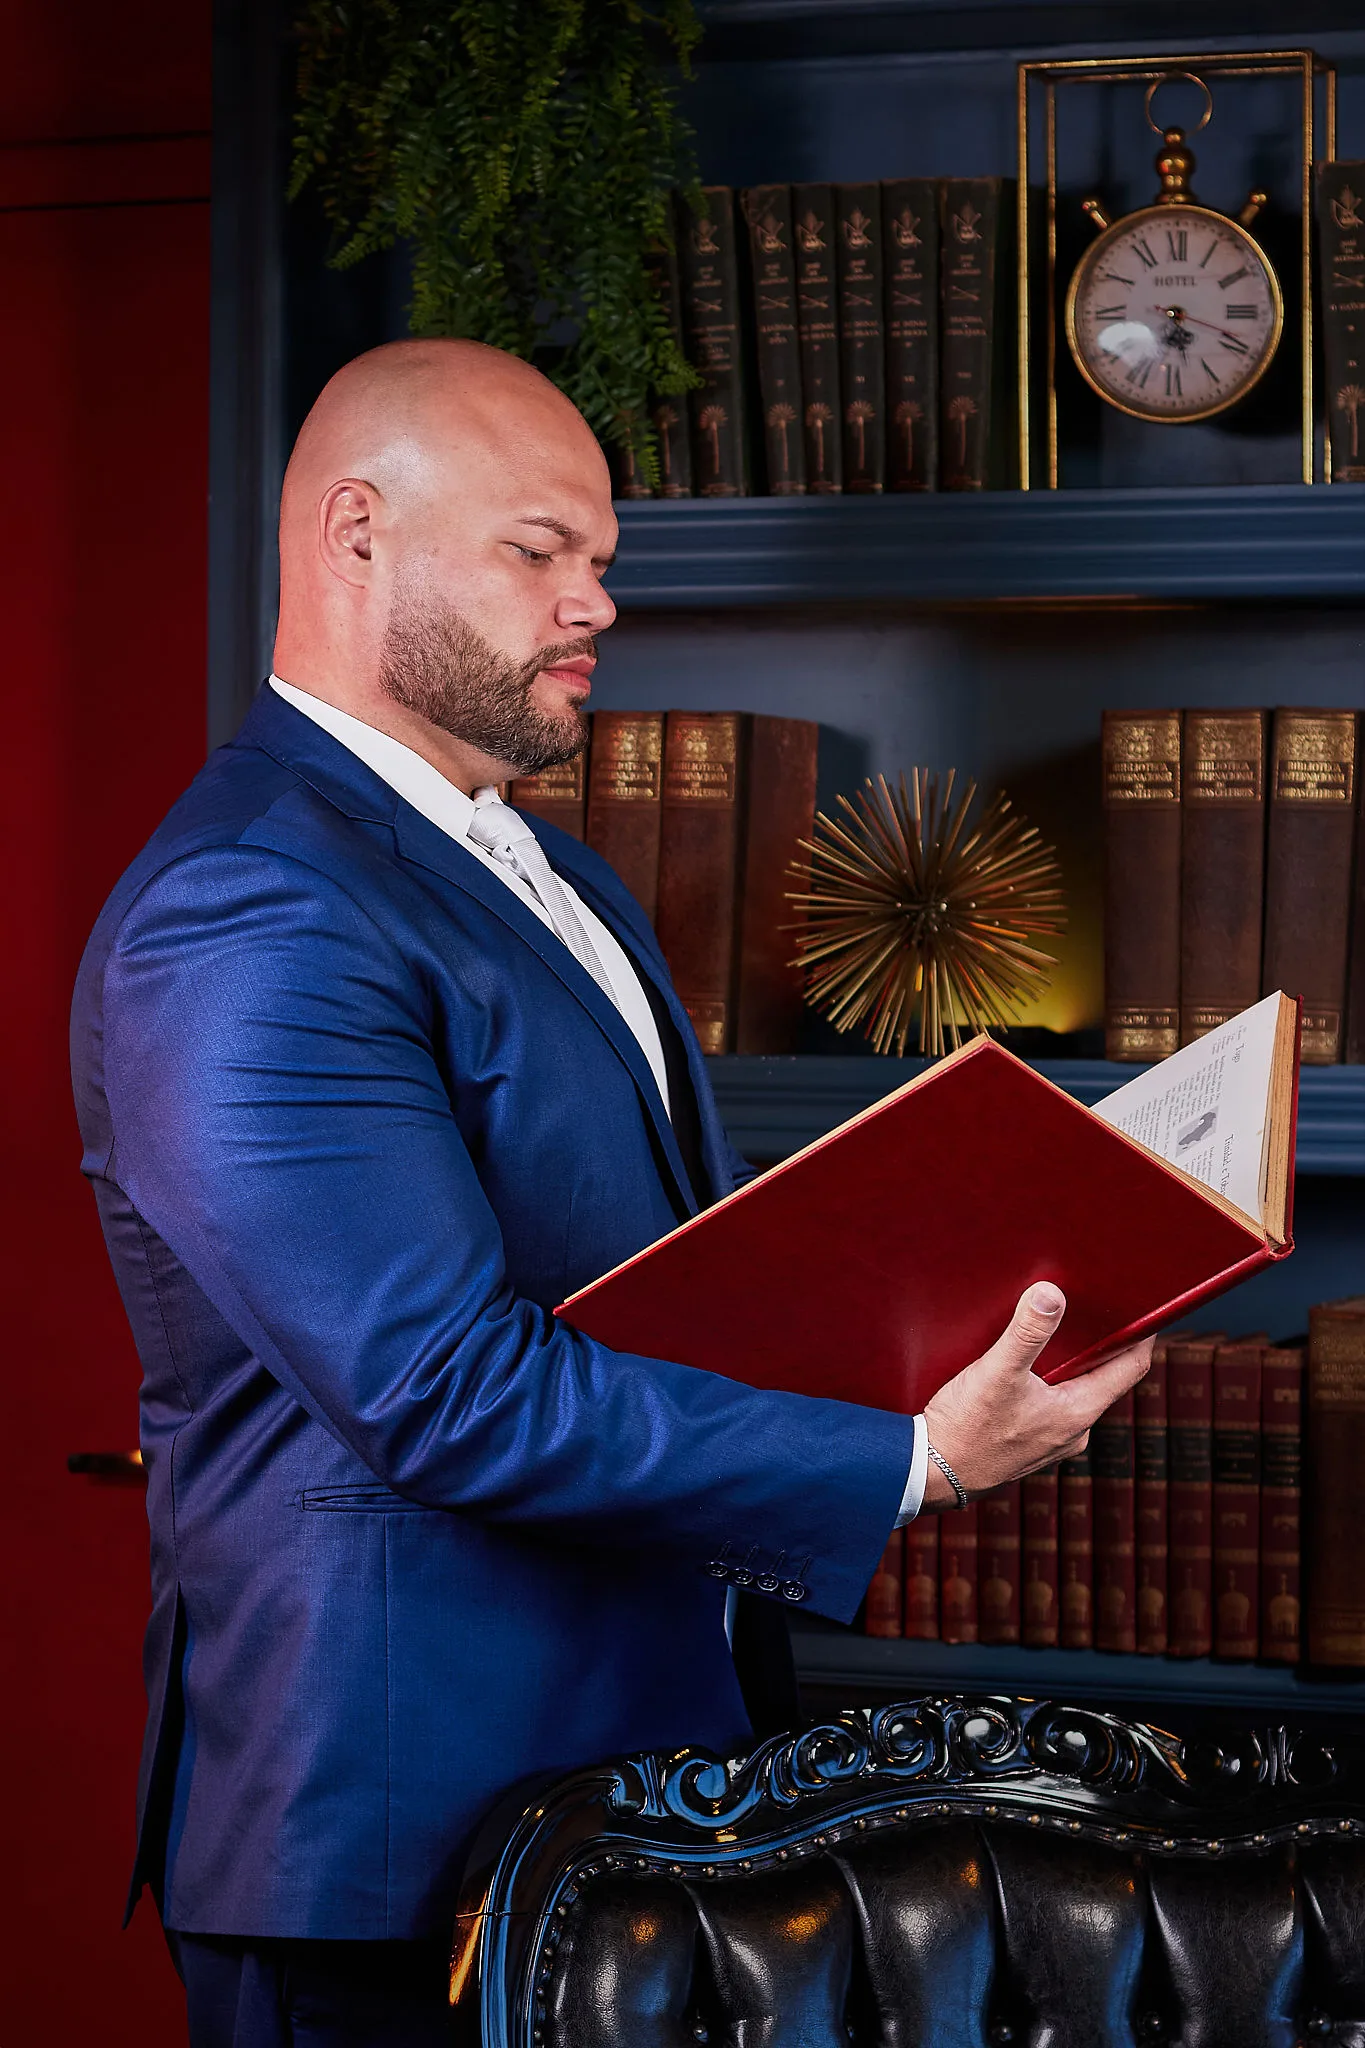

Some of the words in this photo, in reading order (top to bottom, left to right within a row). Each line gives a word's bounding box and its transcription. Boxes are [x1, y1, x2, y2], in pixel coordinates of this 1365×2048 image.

[1166, 230, 1187, 262] XII
[1154, 275, 1198, 287] HOTEL
[1226, 304, 1259, 320] III
[1112, 762, 1169, 772] BIBLIOTECA
[1195, 761, 1250, 771] BIBLIOTECA
[1287, 761, 1342, 772] BIBLIOTECA
[1108, 771, 1173, 782] INTERNACIONAL
[1191, 771, 1255, 781] INTERNACIONAL
[1281, 771, 1345, 783] INTERNACIONAL
[1232, 1042, 1245, 1064] Togo
[1222, 1133, 1234, 1167] Trinidad
